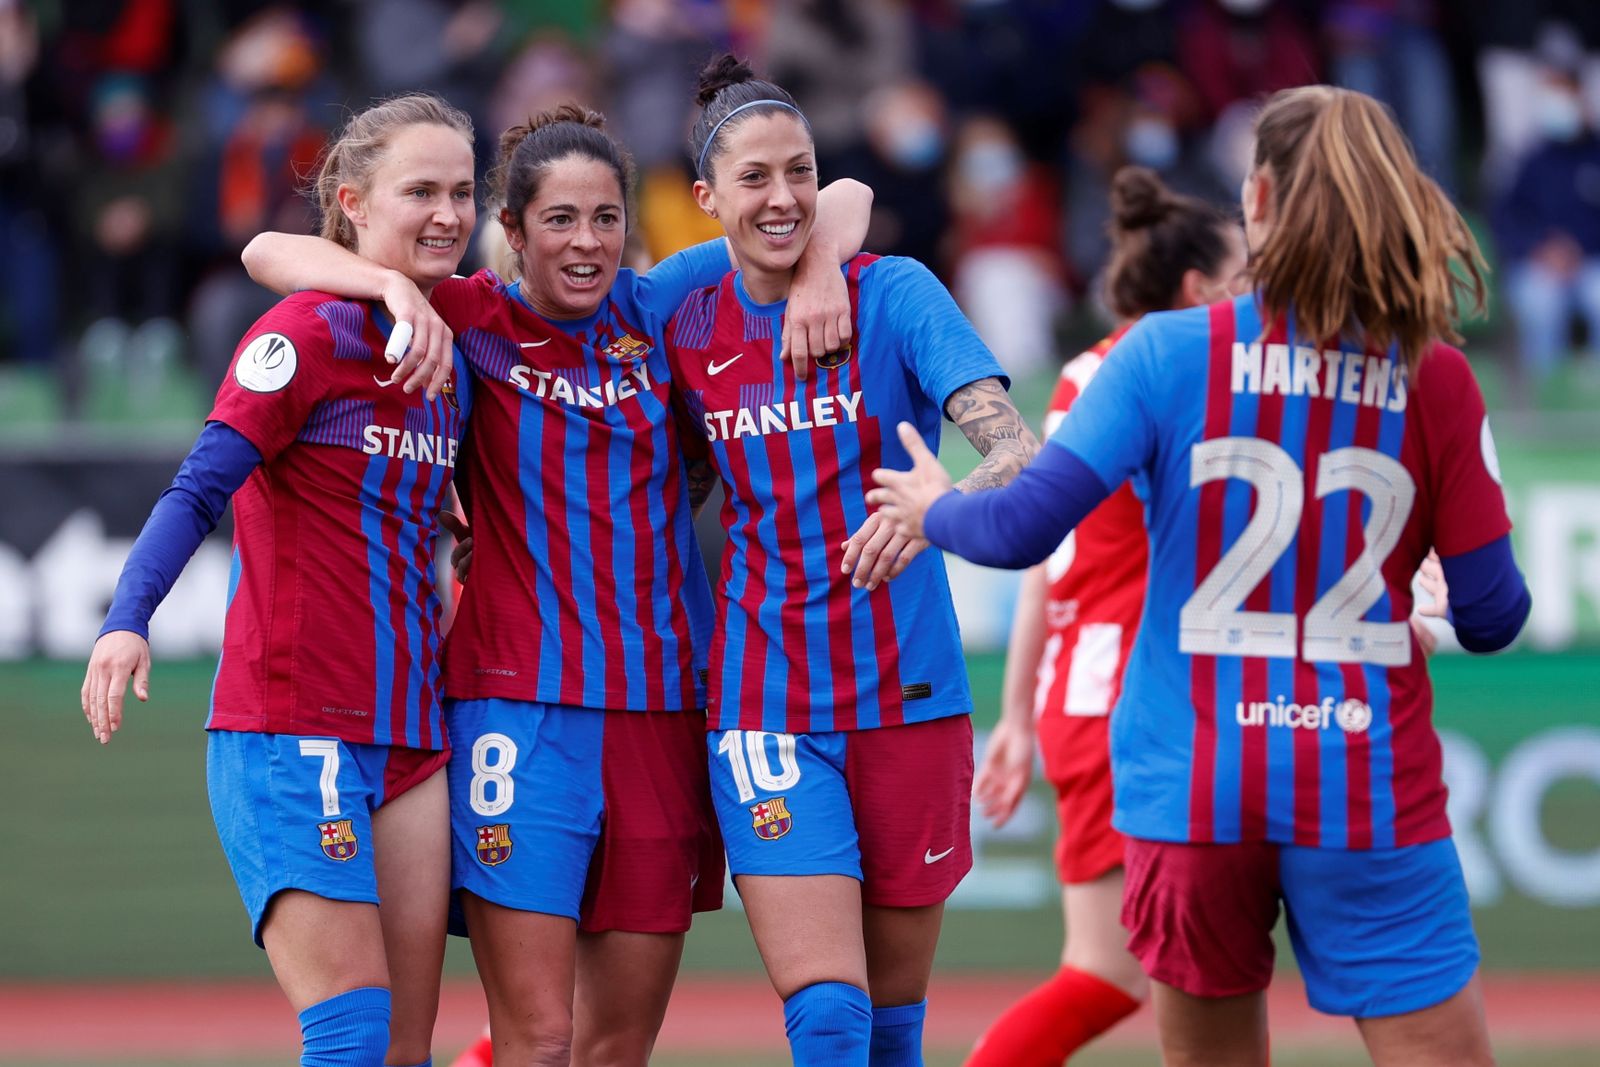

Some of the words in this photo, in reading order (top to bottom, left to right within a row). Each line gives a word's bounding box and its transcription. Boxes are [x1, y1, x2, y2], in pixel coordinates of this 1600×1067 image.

[508, 362, 651, 409] STANLEY
[1231, 342, 1408, 412] MARTENS
[704, 391, 863, 442] STANLEY
[1179, 437, 1417, 666] 22
[1235, 694, 1335, 730] unicef
[299, 740, 339, 817] 7
[469, 733, 518, 817] 8
[718, 729, 801, 804] 10
